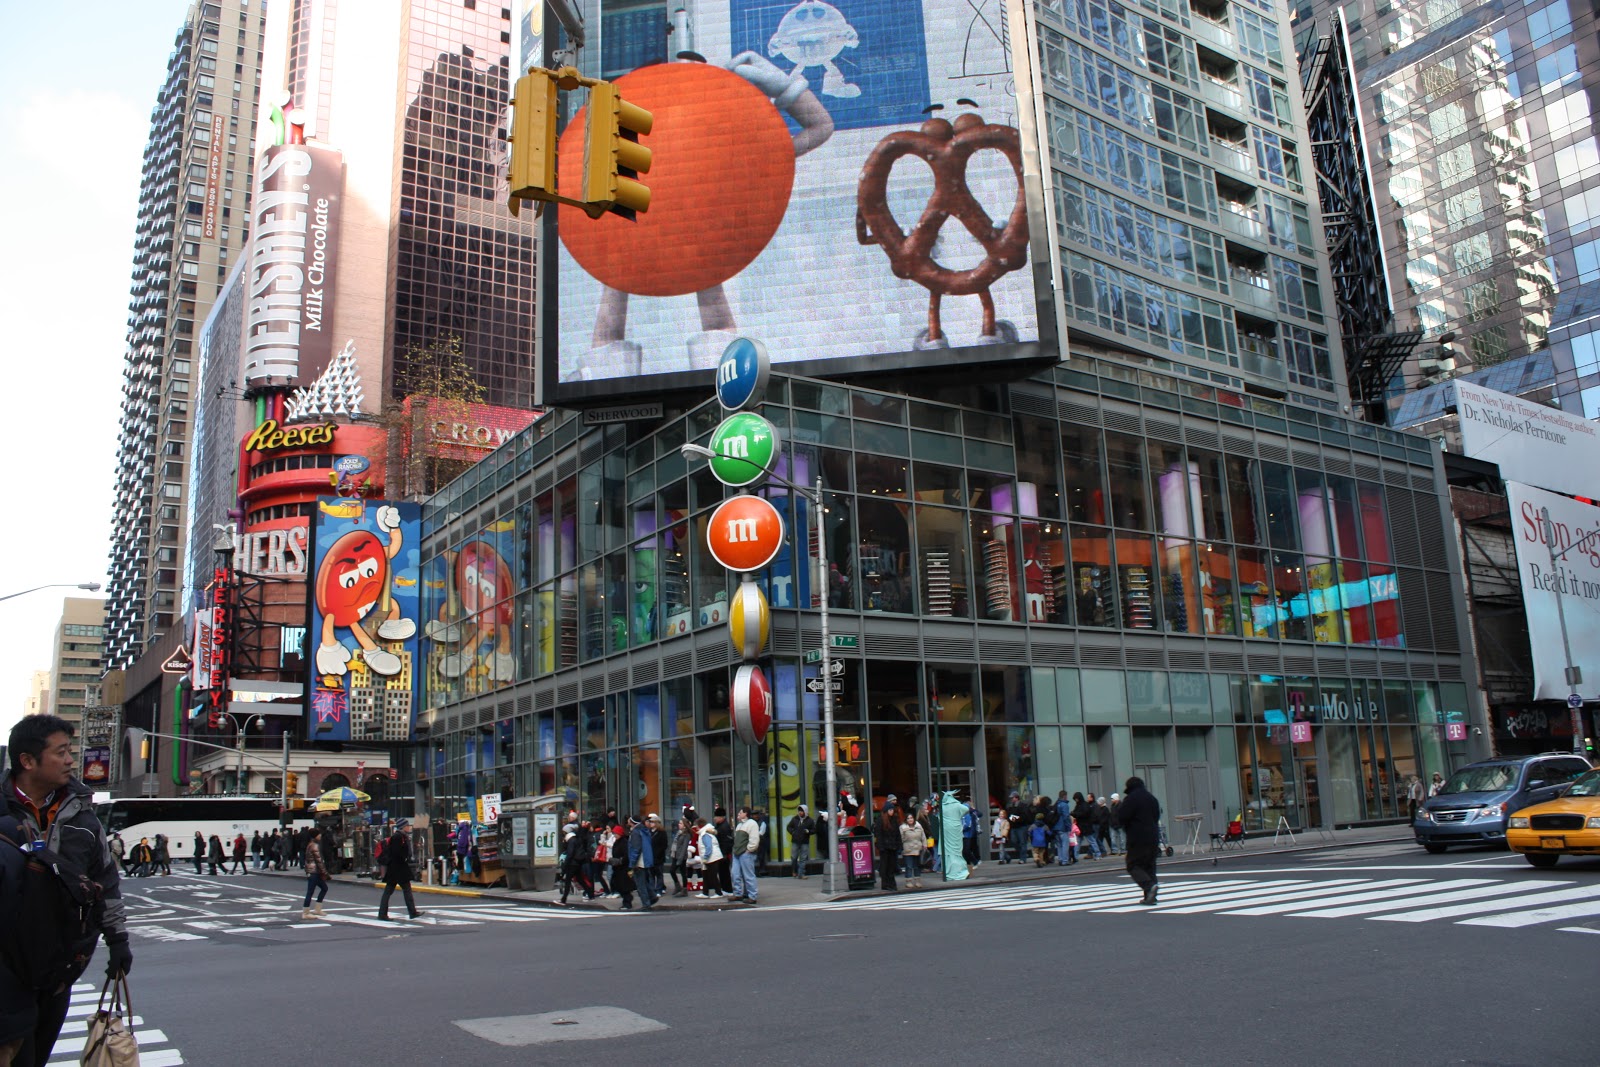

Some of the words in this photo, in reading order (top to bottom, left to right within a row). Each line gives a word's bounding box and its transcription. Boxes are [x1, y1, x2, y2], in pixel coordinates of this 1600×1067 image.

[213, 116, 222, 153] RENTAL
[211, 155, 219, 179] APTS
[307, 198, 329, 286] Chocolate
[244, 150, 312, 384] HERSHEY'S
[305, 287, 323, 331] Milk
[588, 406, 658, 422] SHERWOOD
[1460, 387, 1480, 401] From
[1482, 394, 1499, 407] New
[1499, 398, 1516, 413] York
[1540, 412, 1574, 432] bestselling
[1463, 403, 1481, 421] Dr.
[1482, 408, 1523, 434] Nicholas
[1525, 420, 1567, 445] Perricone
[245, 419, 336, 452] Reese's
[722, 434, 749, 460] m
[728, 518, 759, 543] m
[1529, 562, 1567, 594] Read
[1569, 569, 1580, 596] it
[1582, 580, 1600, 600] no
[838, 637, 844, 646] 7
[1294, 725, 1306, 740] T
[1450, 724, 1461, 738] T
[488, 806, 497, 820] 3
